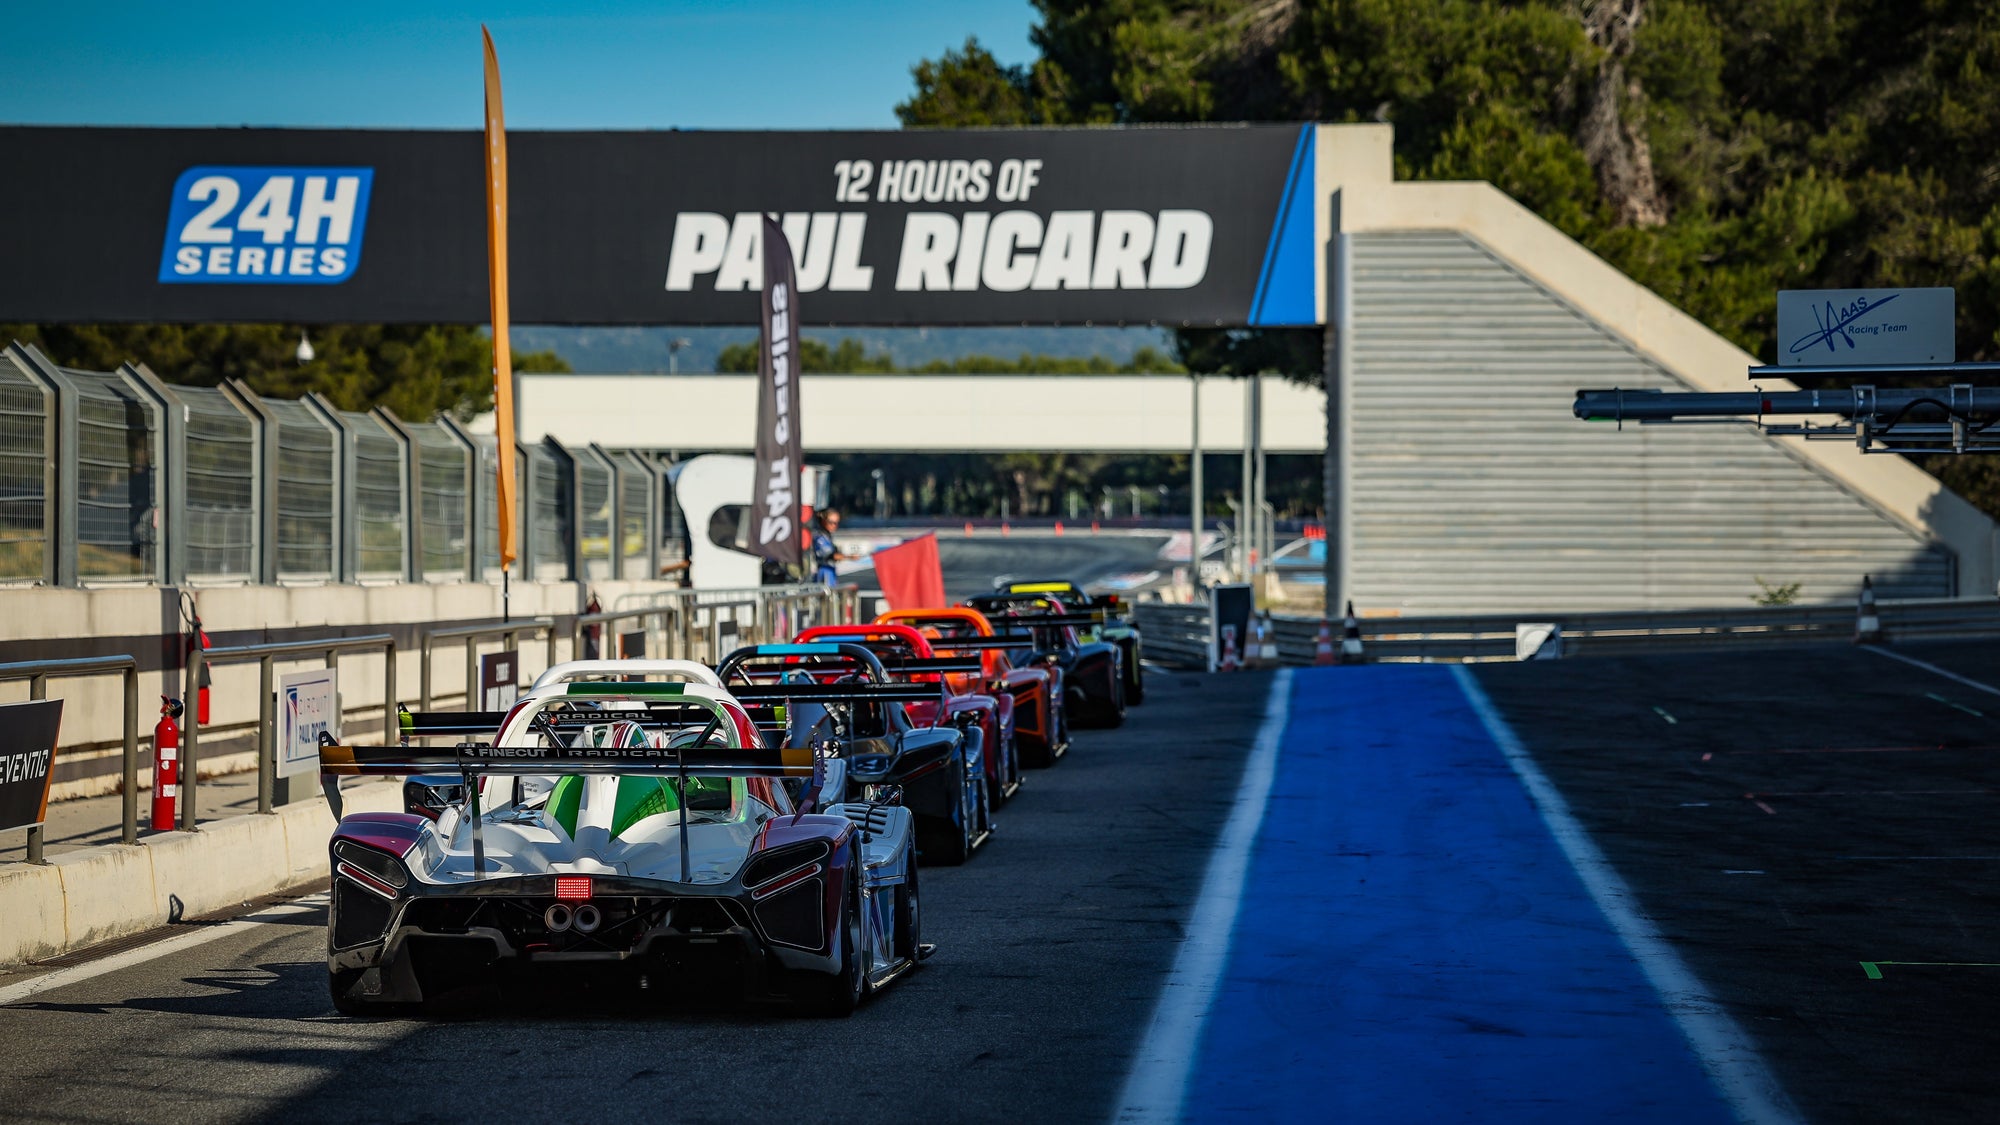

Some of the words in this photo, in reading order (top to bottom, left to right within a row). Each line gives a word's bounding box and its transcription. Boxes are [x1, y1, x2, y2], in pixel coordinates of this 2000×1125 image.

[834, 161, 873, 202] 12
[877, 160, 992, 202] HOURS
[996, 159, 1043, 202] OF
[179, 176, 360, 244] 24H
[174, 246, 347, 276] SERIES
[665, 212, 874, 292] PAUL
[894, 209, 1214, 291] RICARD
[1848, 325, 1879, 335] Racing
[1882, 324, 1907, 332] Team
[556, 712, 653, 720] RADICAL
[479, 748, 548, 758] FINECUT
